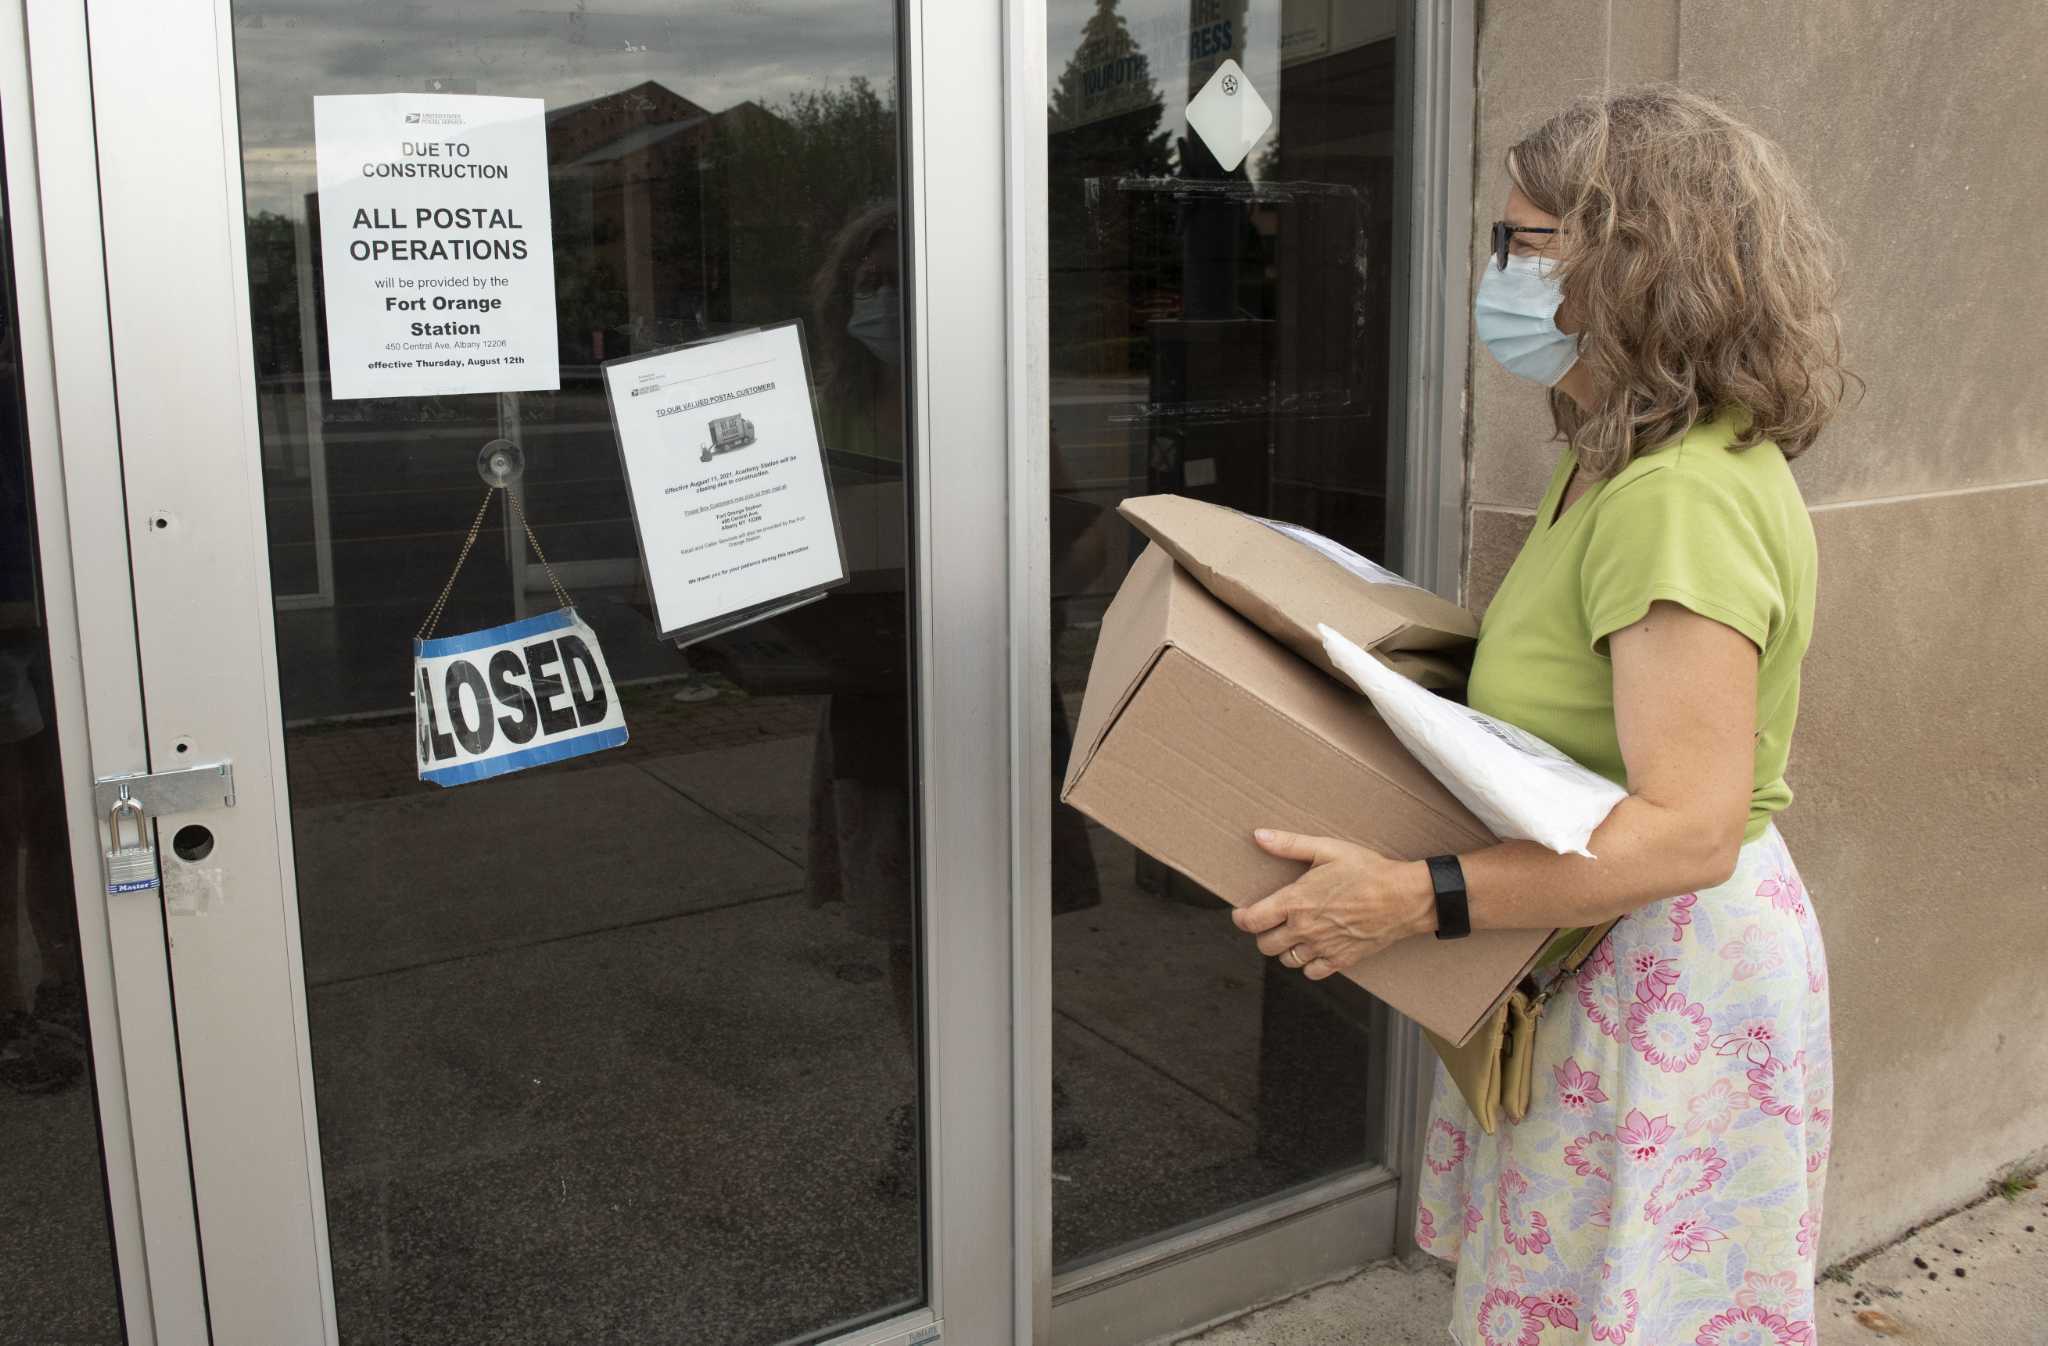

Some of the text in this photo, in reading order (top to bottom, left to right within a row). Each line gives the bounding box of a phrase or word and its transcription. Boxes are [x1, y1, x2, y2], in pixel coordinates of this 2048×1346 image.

[402, 142, 470, 157] DUE TO
[362, 163, 508, 179] CONSTRUCTION
[352, 208, 522, 229] ALL POSTAL
[350, 239, 528, 261] OPERATIONS
[375, 276, 509, 291] will be provided by the
[385, 296, 502, 313] Fort Orange
[411, 321, 481, 336] Station
[385, 343, 401, 351] 450
[402, 342, 433, 350] Central
[454, 341, 481, 351] Albany
[368, 356, 525, 369] effective Thursday, August 12th
[710, 392, 735, 404] POSTAL
[736, 382, 776, 398] CUSTOMERS
[119, 883, 149, 891] Master
